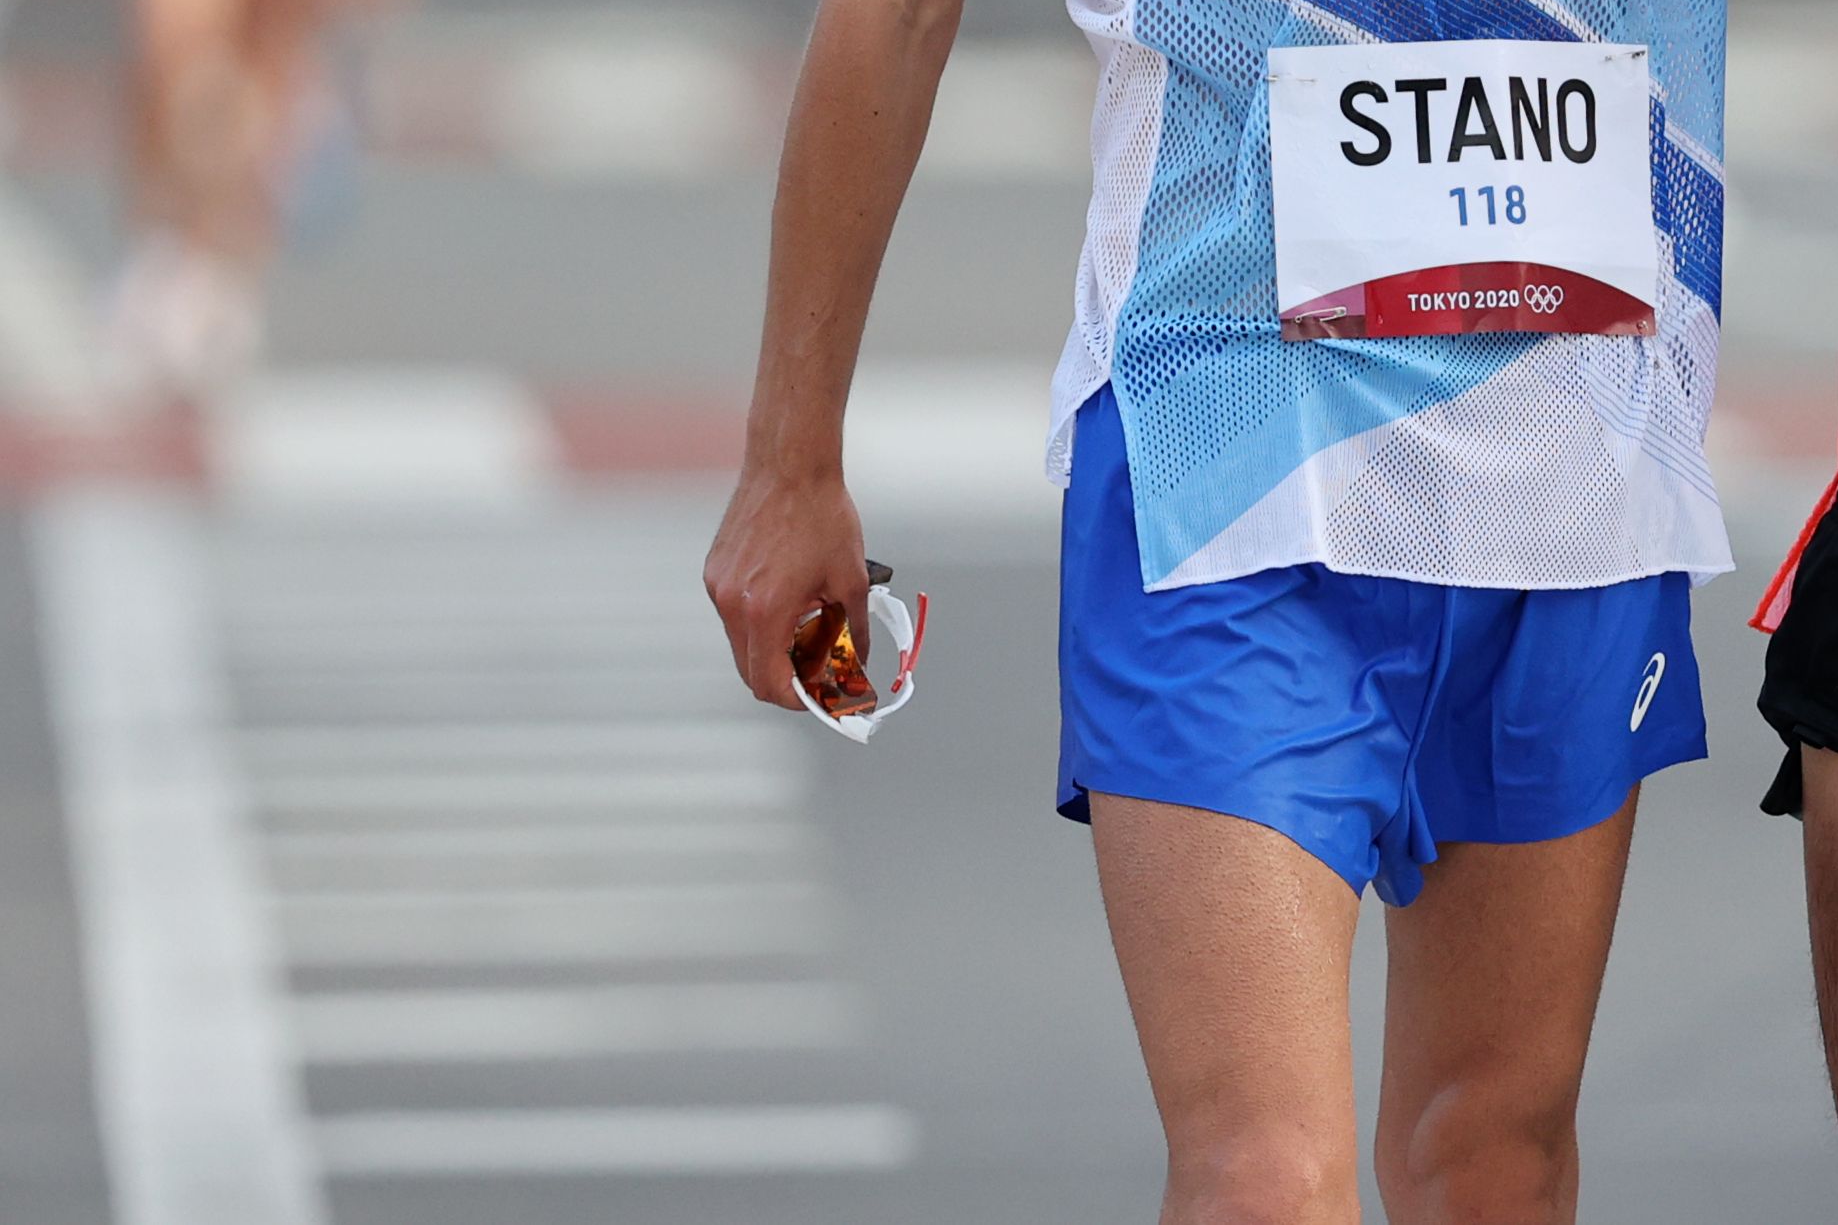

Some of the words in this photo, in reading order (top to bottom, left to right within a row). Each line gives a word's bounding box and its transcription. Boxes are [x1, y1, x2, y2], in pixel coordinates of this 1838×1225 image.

[1339, 76, 1597, 167] STANO
[1449, 184, 1527, 226] 118
[1407, 290, 1471, 312] TOKYO
[1474, 288, 1520, 310] 2020
